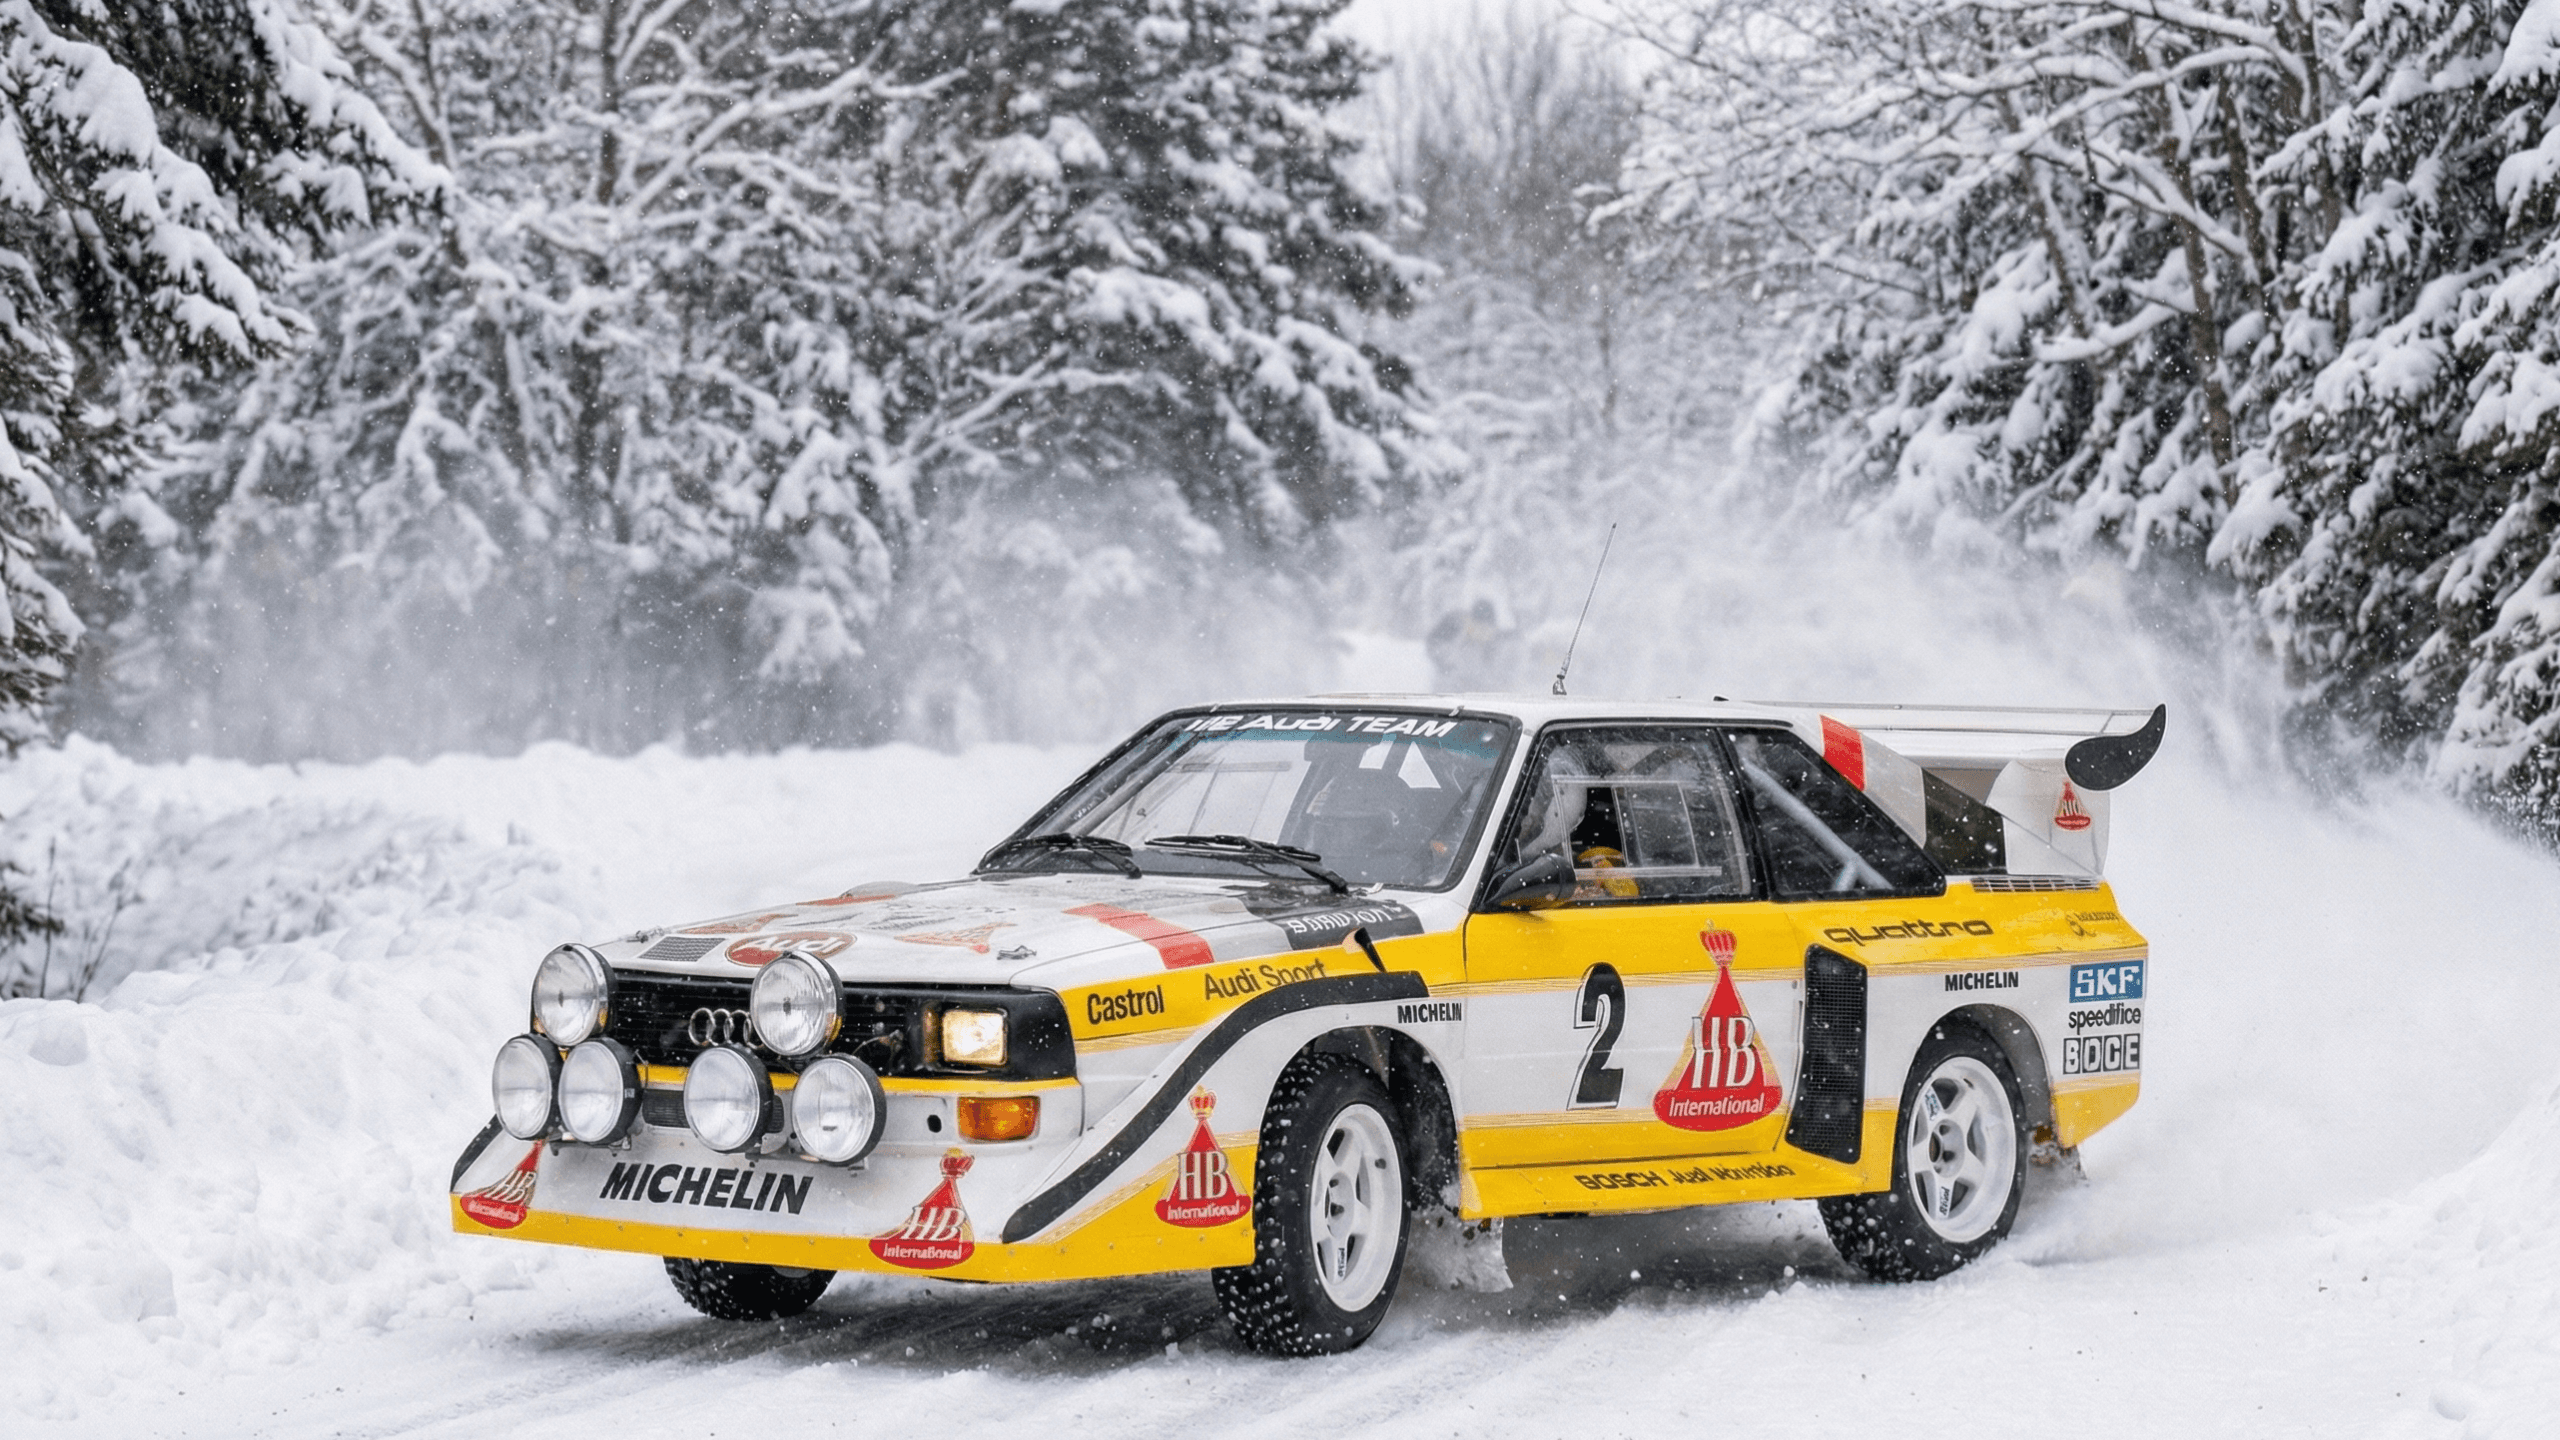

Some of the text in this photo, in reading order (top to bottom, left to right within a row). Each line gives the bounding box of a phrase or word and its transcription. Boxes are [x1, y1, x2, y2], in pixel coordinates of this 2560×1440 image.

[1346, 716, 1458, 738] TEAM
[1823, 919, 1995, 947] quattro
[1204, 957, 1328, 1001] Audi Sport
[1944, 971, 2019, 992] MICHELIN
[2074, 965, 2140, 998] SKF
[1086, 984, 1166, 1026] Castrol
[1396, 1002, 1463, 1024] MICHELIN
[1566, 961, 1627, 1111] 2
[1691, 1015, 1756, 1089] HB
[1668, 1092, 1765, 1118] International
[599, 1161, 814, 1215] MICHELIN
[1177, 1150, 1229, 1201] HB
[900, 1206, 967, 1242] HB
